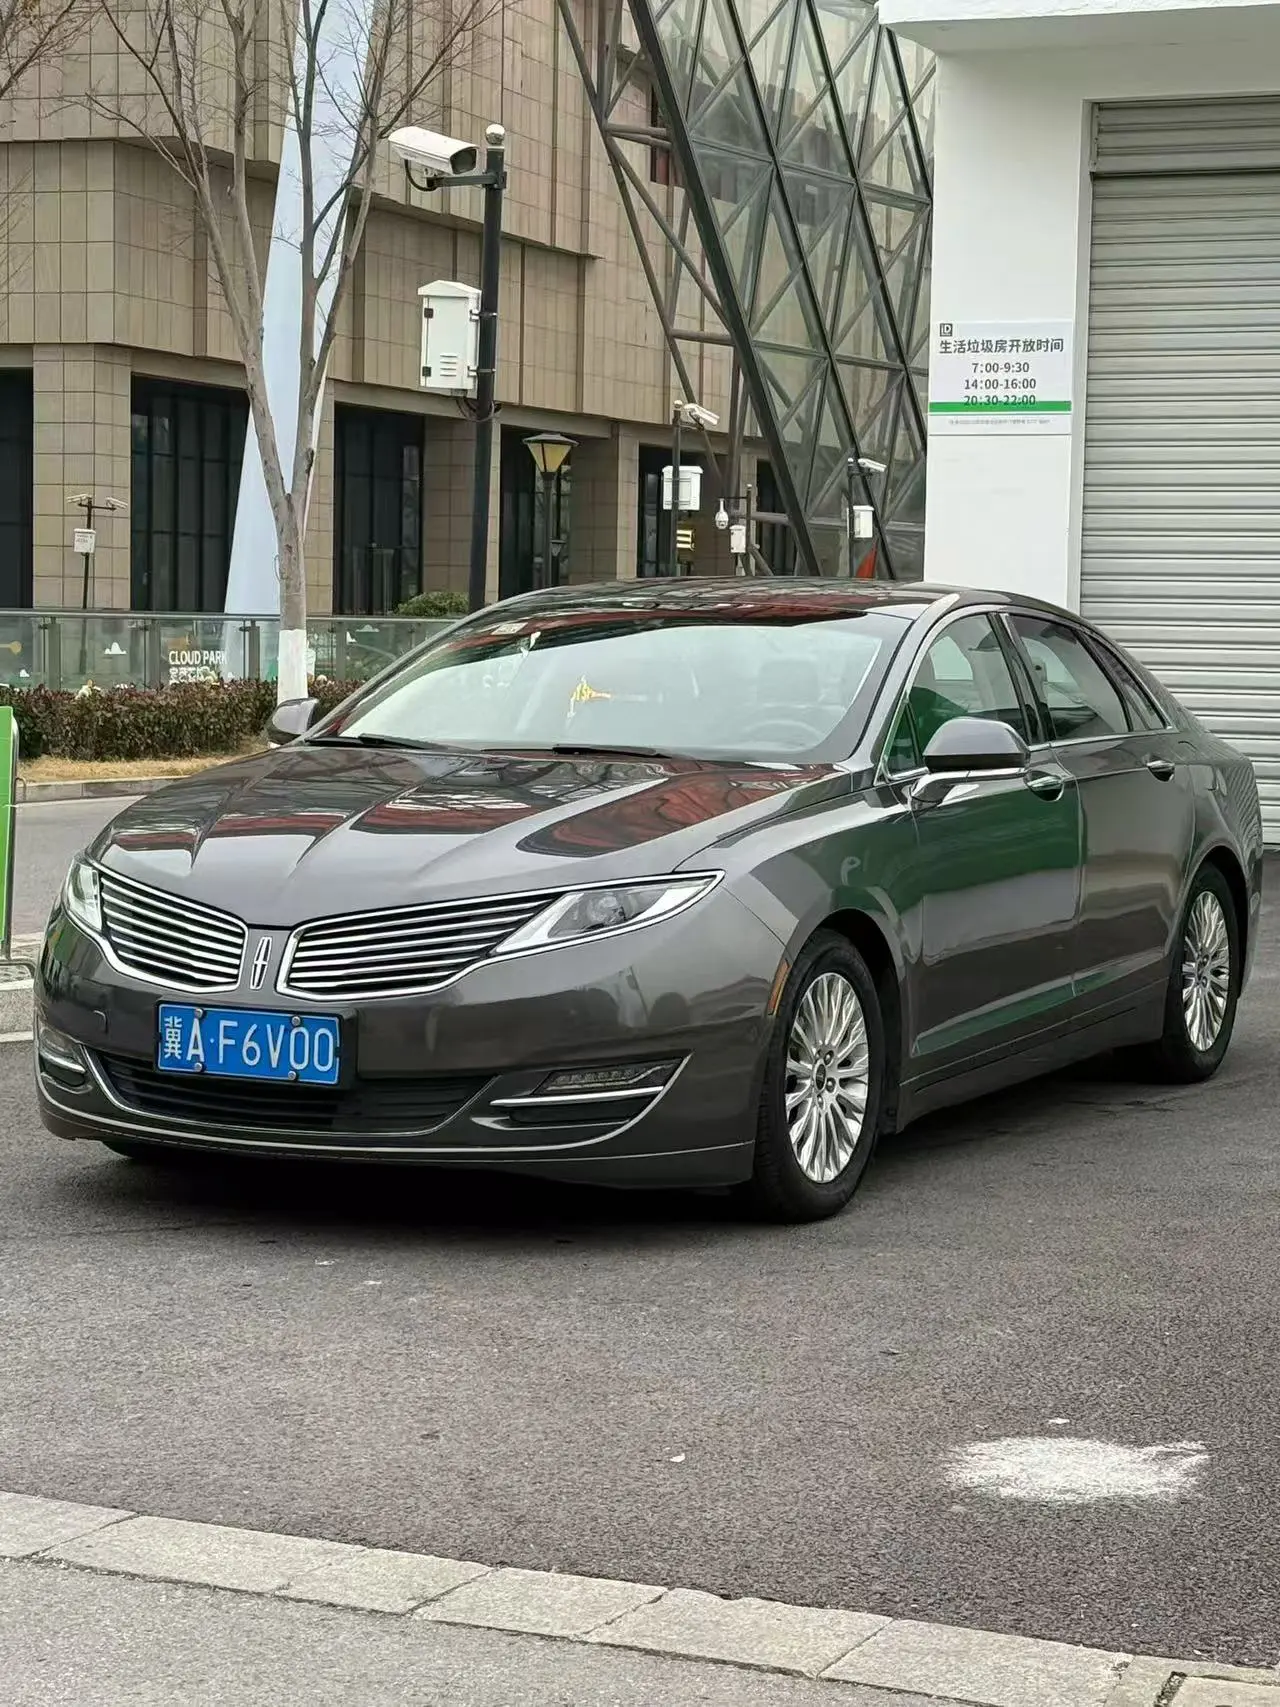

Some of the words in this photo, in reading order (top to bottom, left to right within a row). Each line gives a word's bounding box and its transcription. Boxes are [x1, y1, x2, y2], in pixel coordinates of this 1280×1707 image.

[939, 339, 1064, 354] 生活垃圾房开放时间
[972, 362, 1030, 373] 7:00-9:30
[964, 378, 1037, 390] 14:00-16:00
[963, 395, 1036, 406] 20:30-22:00
[169, 650, 201, 665] CLOUD
[203, 650, 228, 665] PARK
